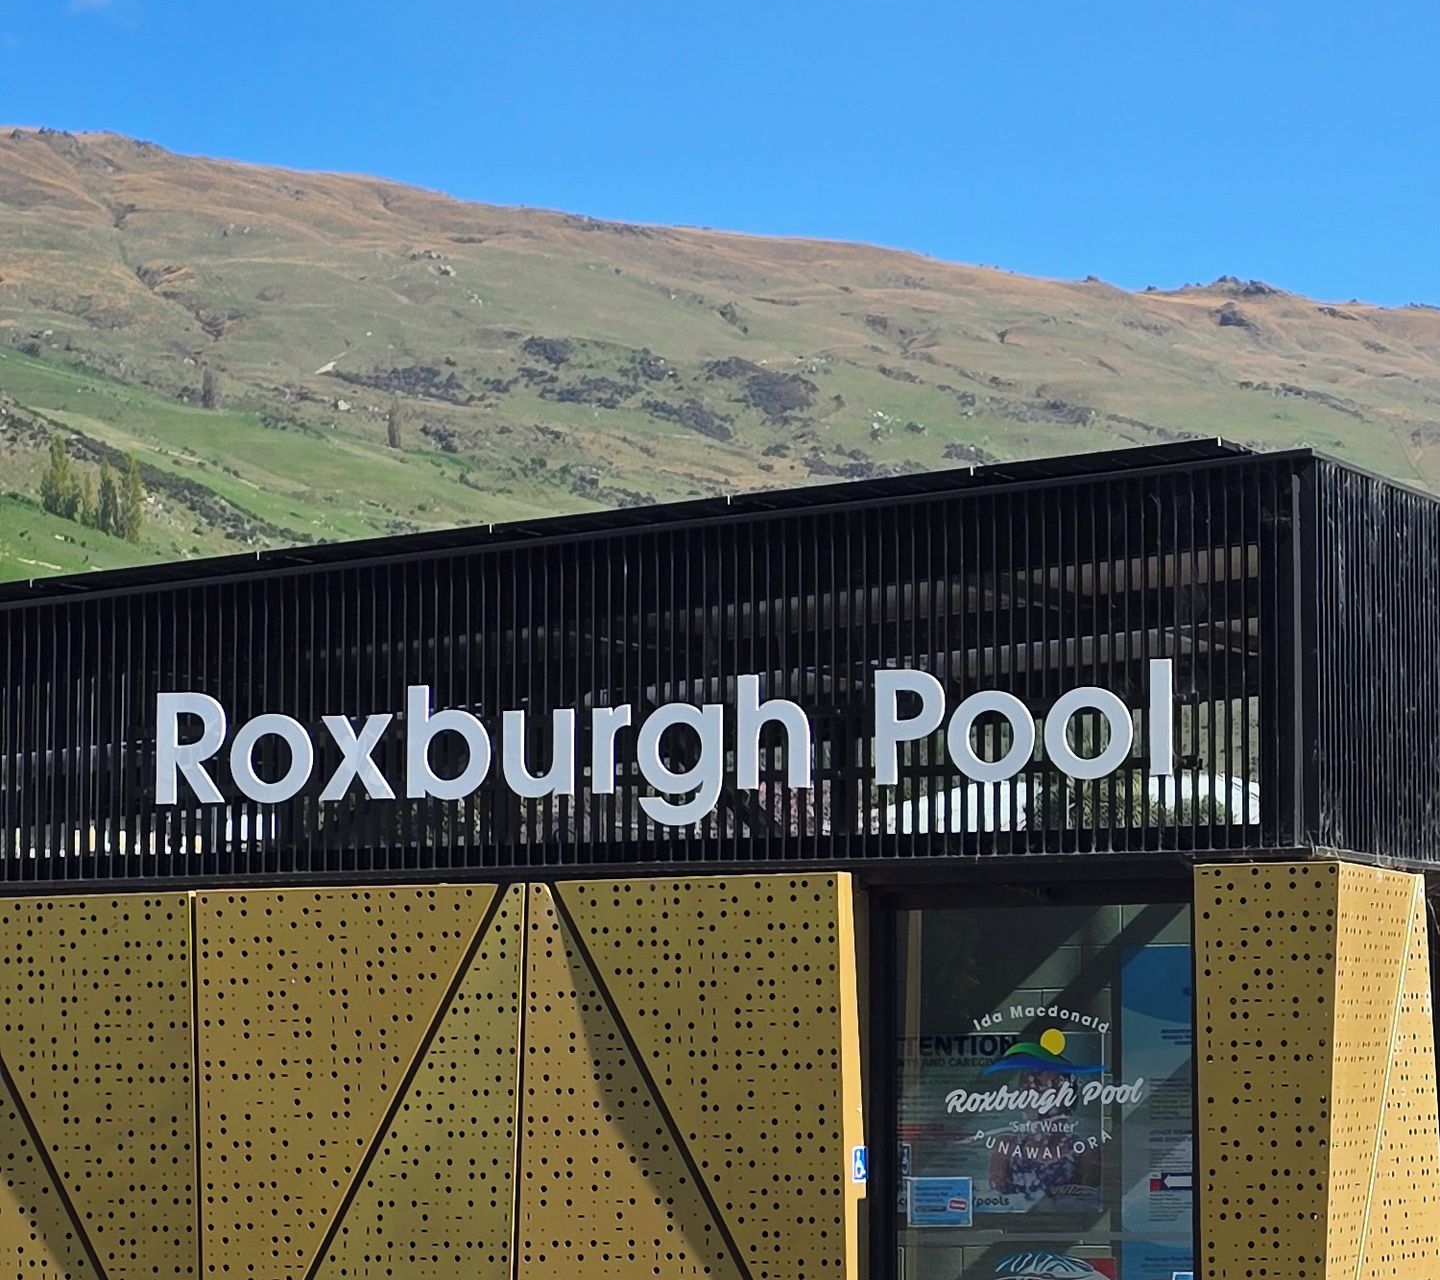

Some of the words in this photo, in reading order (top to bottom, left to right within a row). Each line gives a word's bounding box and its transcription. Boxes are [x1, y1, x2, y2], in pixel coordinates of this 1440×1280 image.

[156, 674, 811, 826] Roxburgh
[874, 658, 1173, 785] Pool
[973, 1012, 1002, 1031] Ida
[1010, 1005, 1110, 1034] Macdonald
[945, 1080, 1076, 1114] Roxburgh
[1082, 1077, 1144, 1106] Pool
[973, 1129, 1061, 1159] PUNAWAI
[1073, 1130, 1112, 1154] ORA
